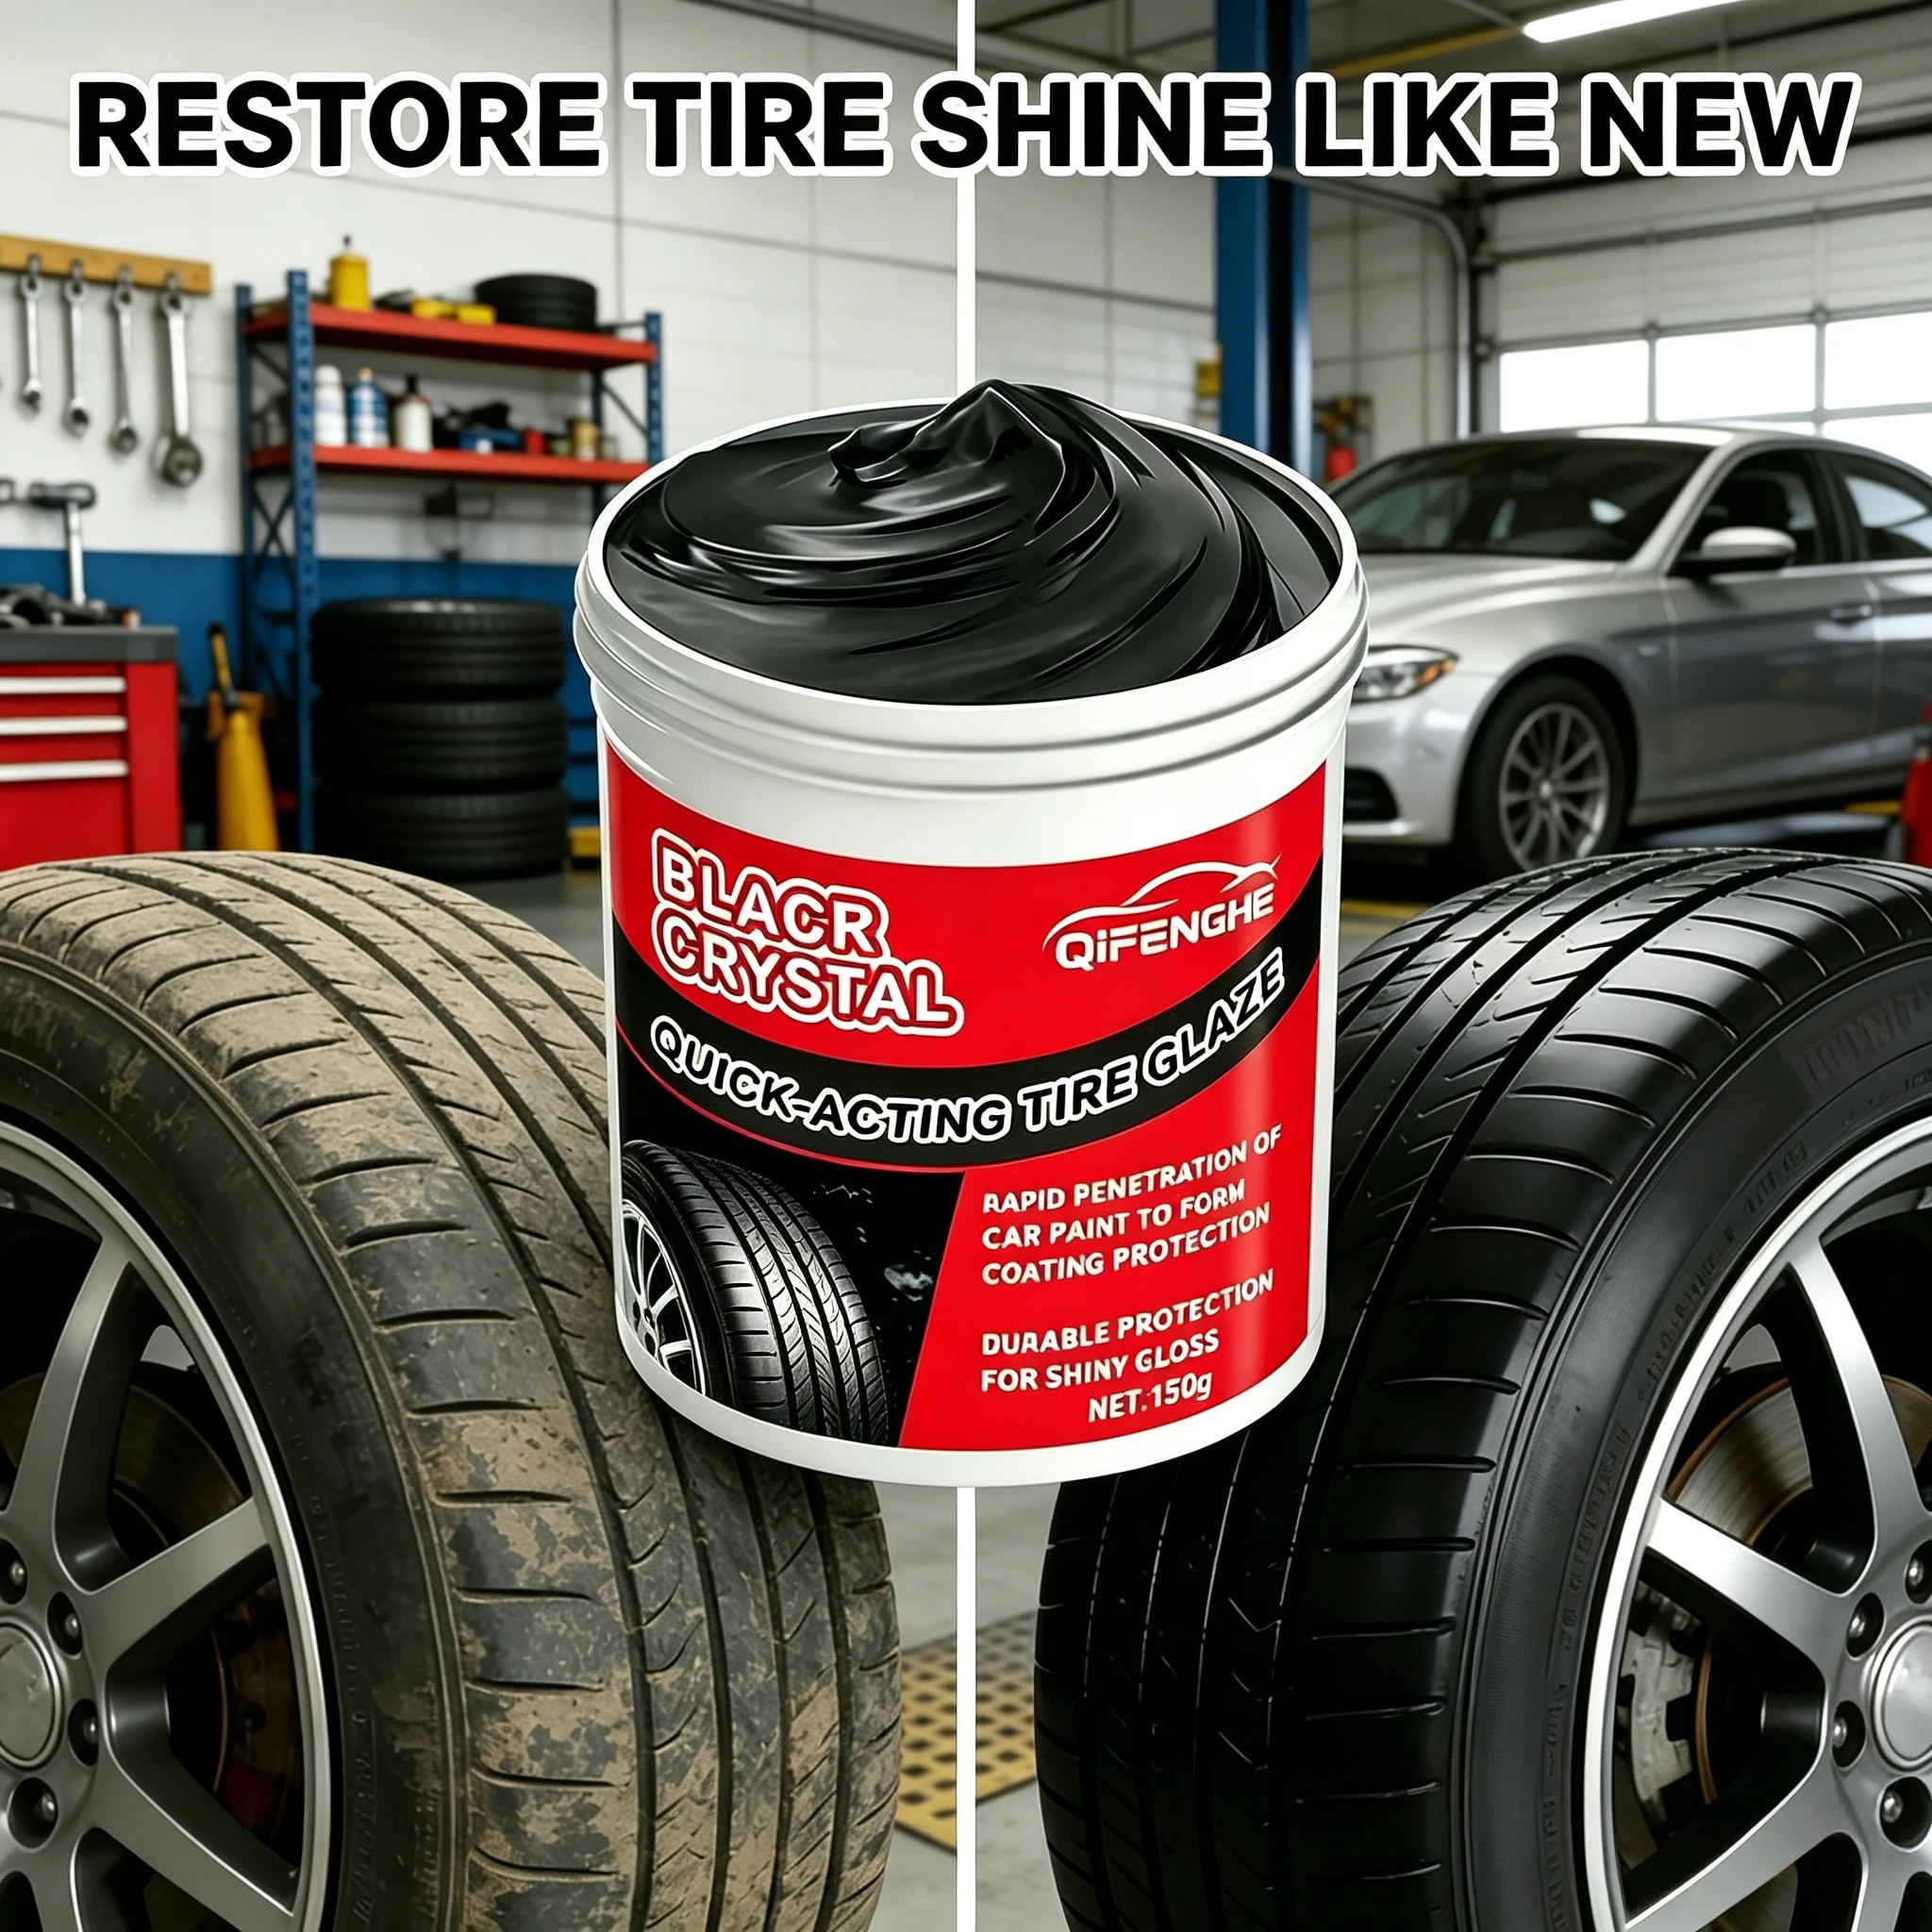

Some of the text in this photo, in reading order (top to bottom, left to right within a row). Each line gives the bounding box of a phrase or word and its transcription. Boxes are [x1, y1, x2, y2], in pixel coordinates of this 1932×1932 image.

[652, 904, 963, 1036] CRYSTAL
[650, 946, 1286, 1145] QUICK-ACTING TIRE GLAZE
[982, 1124, 1282, 1214] RAPID PENETRATION OF
[982, 1178, 1245, 1250] CAR PAINT TO FORM
[982, 1202, 1271, 1286] COATING PROTECTION
[982, 1268, 1274, 1356] DURABLE PROTECTION
[980, 1328, 1220, 1392] FOR SHINY GLOSS
